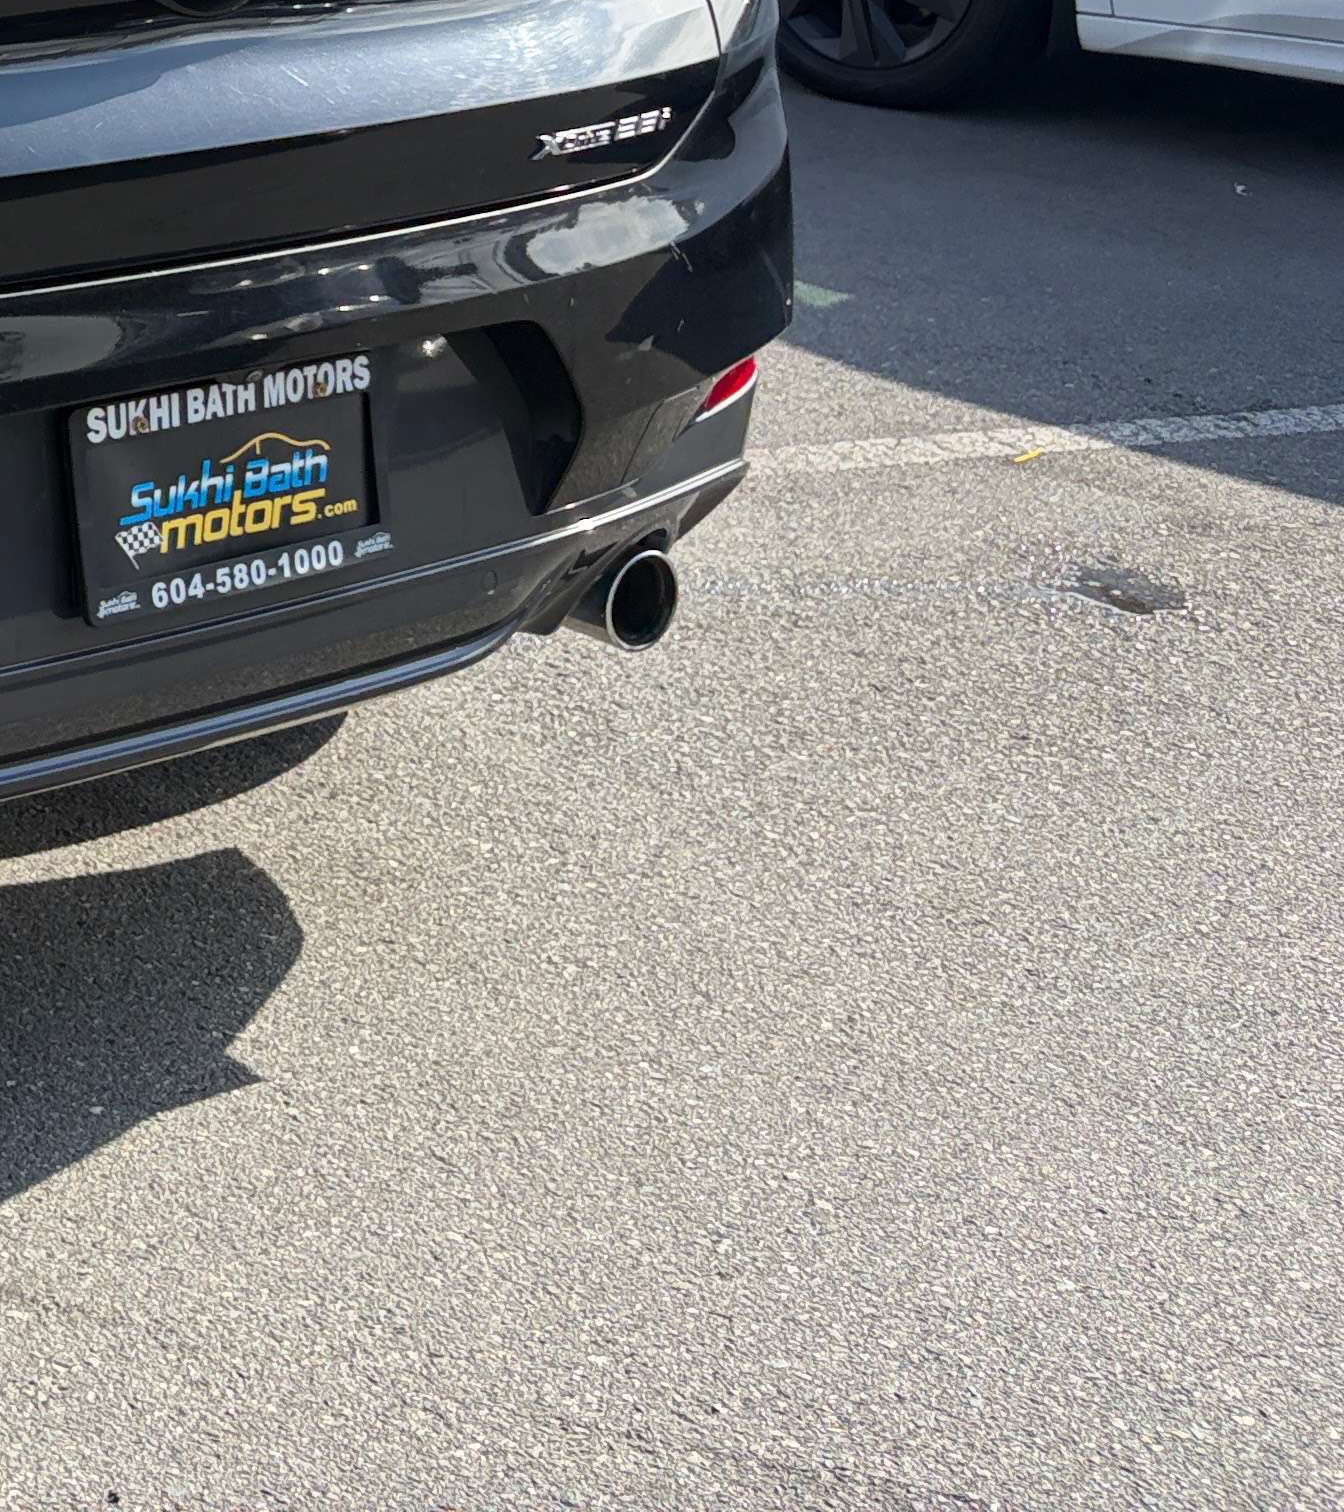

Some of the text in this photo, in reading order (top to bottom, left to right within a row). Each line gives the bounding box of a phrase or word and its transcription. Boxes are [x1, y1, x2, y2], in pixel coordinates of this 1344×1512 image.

[86, 355, 371, 444] SUKHI BATH MOTORS
[119, 449, 328, 526] Sukhi Bath
[151, 540, 345, 609] 604-580-1000
